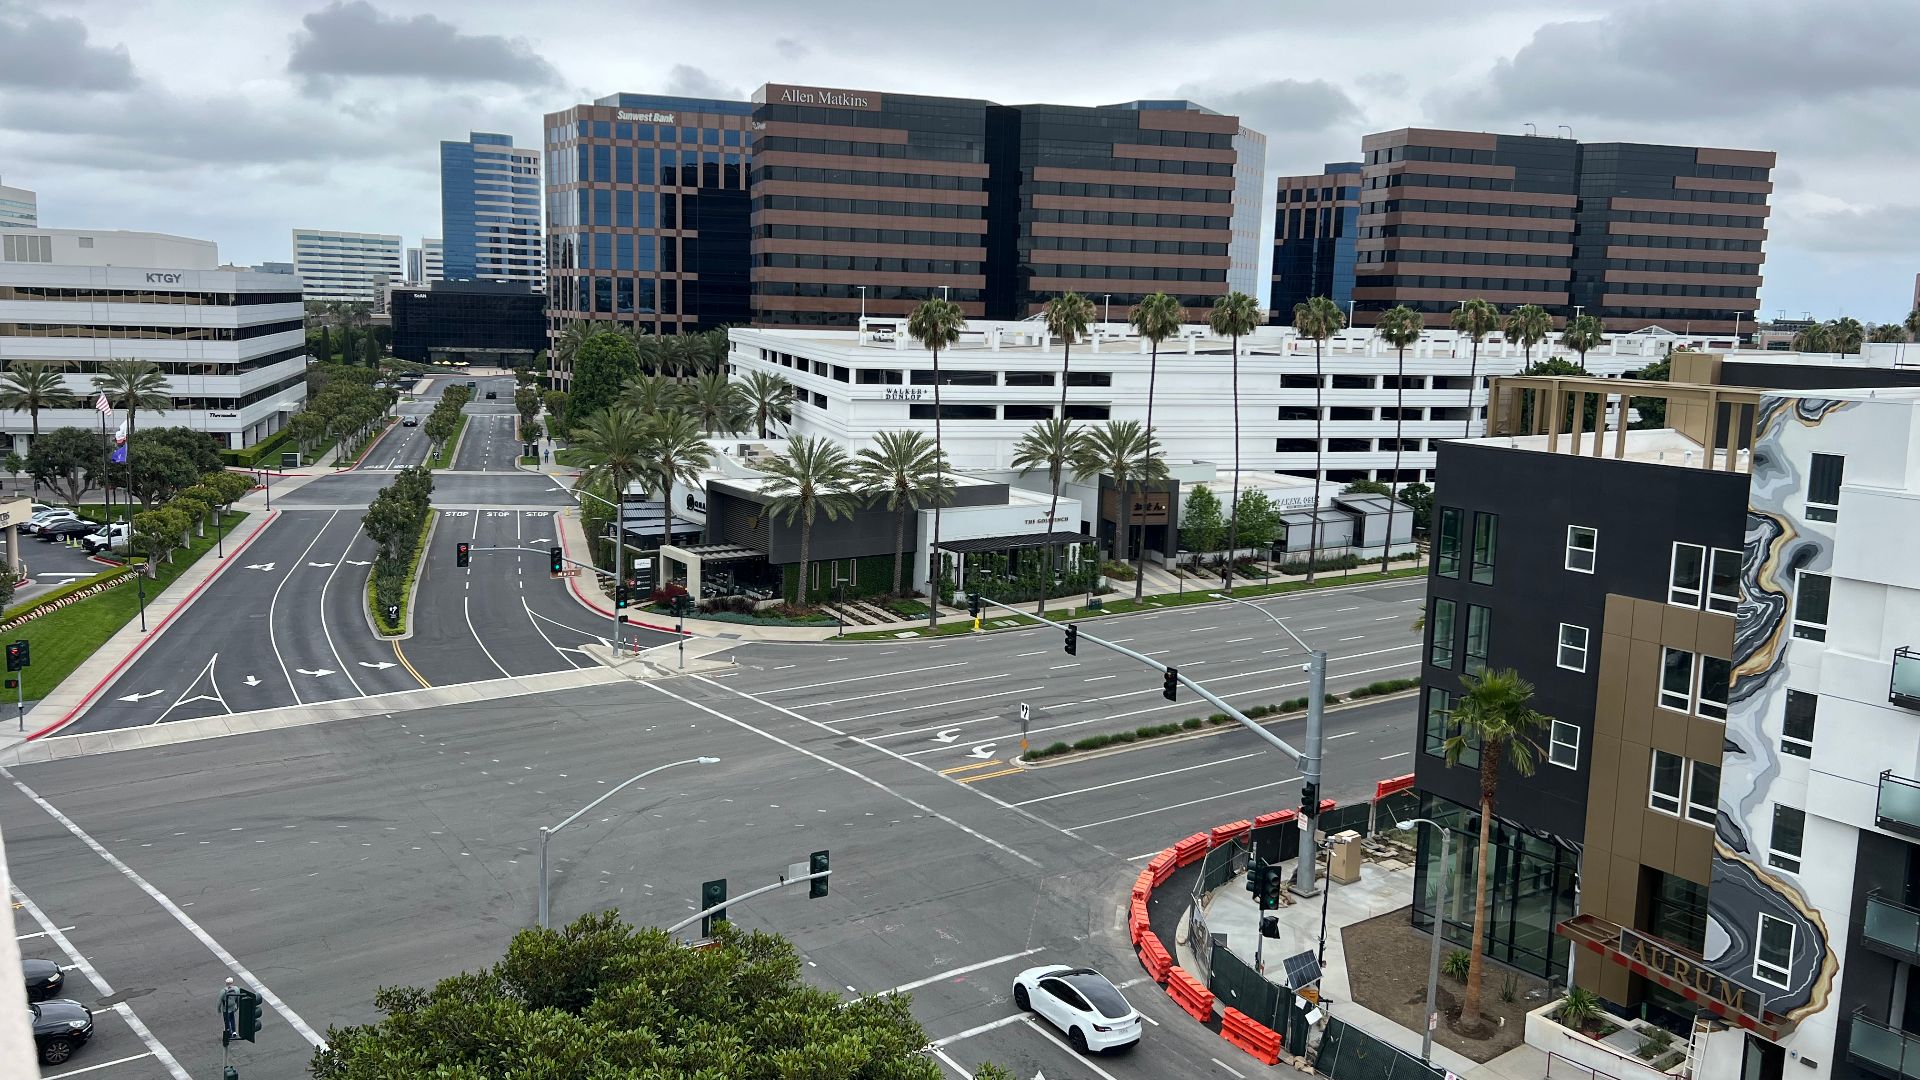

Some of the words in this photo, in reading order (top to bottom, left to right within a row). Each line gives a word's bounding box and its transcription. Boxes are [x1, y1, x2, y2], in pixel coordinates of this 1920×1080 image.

[781, 89, 814, 103] Allen
[818, 91, 868, 107] Matkins
[617, 110, 653, 122] Sunwest
[653, 112, 674, 124] Bank
[146, 272, 181, 283] KTGY
[1037, 516, 1069, 524] GOLINCH
[1632, 940, 1746, 1013] AURUM
